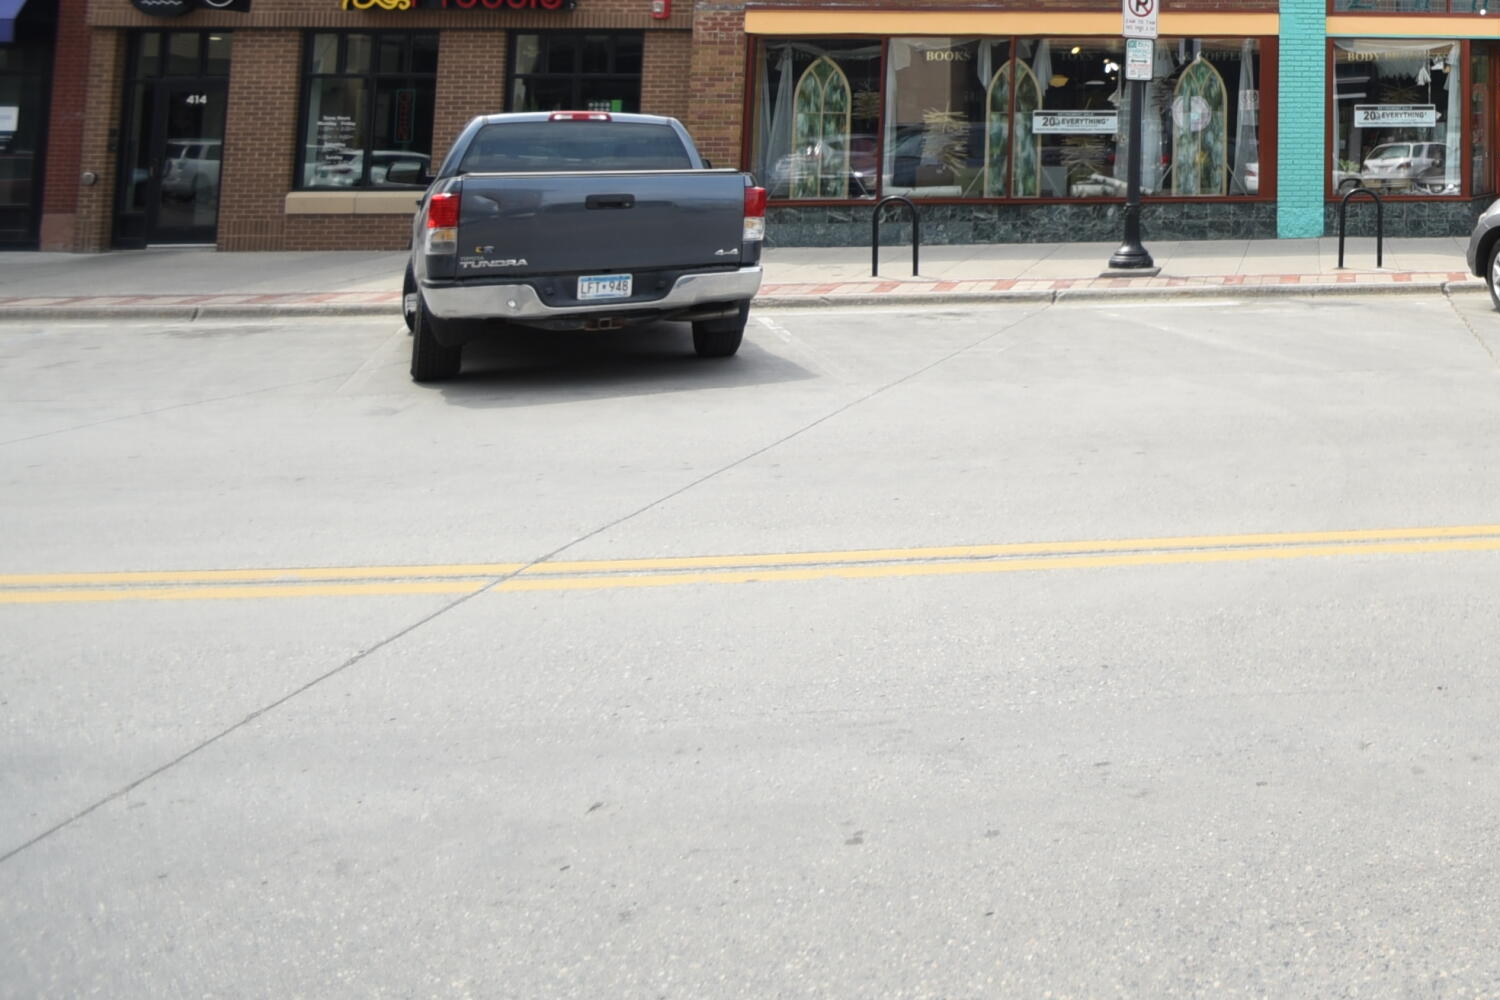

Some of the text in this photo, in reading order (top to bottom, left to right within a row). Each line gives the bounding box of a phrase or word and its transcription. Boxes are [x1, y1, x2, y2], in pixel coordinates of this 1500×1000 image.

[926, 50, 971, 62] BOOKS
[1348, 52, 1378, 61] BODY
[186, 95, 207, 104] 414
[1363, 111, 1376, 120] 20
[1042, 117, 1055, 126] 20
[459, 259, 528, 268] TUNDRA
